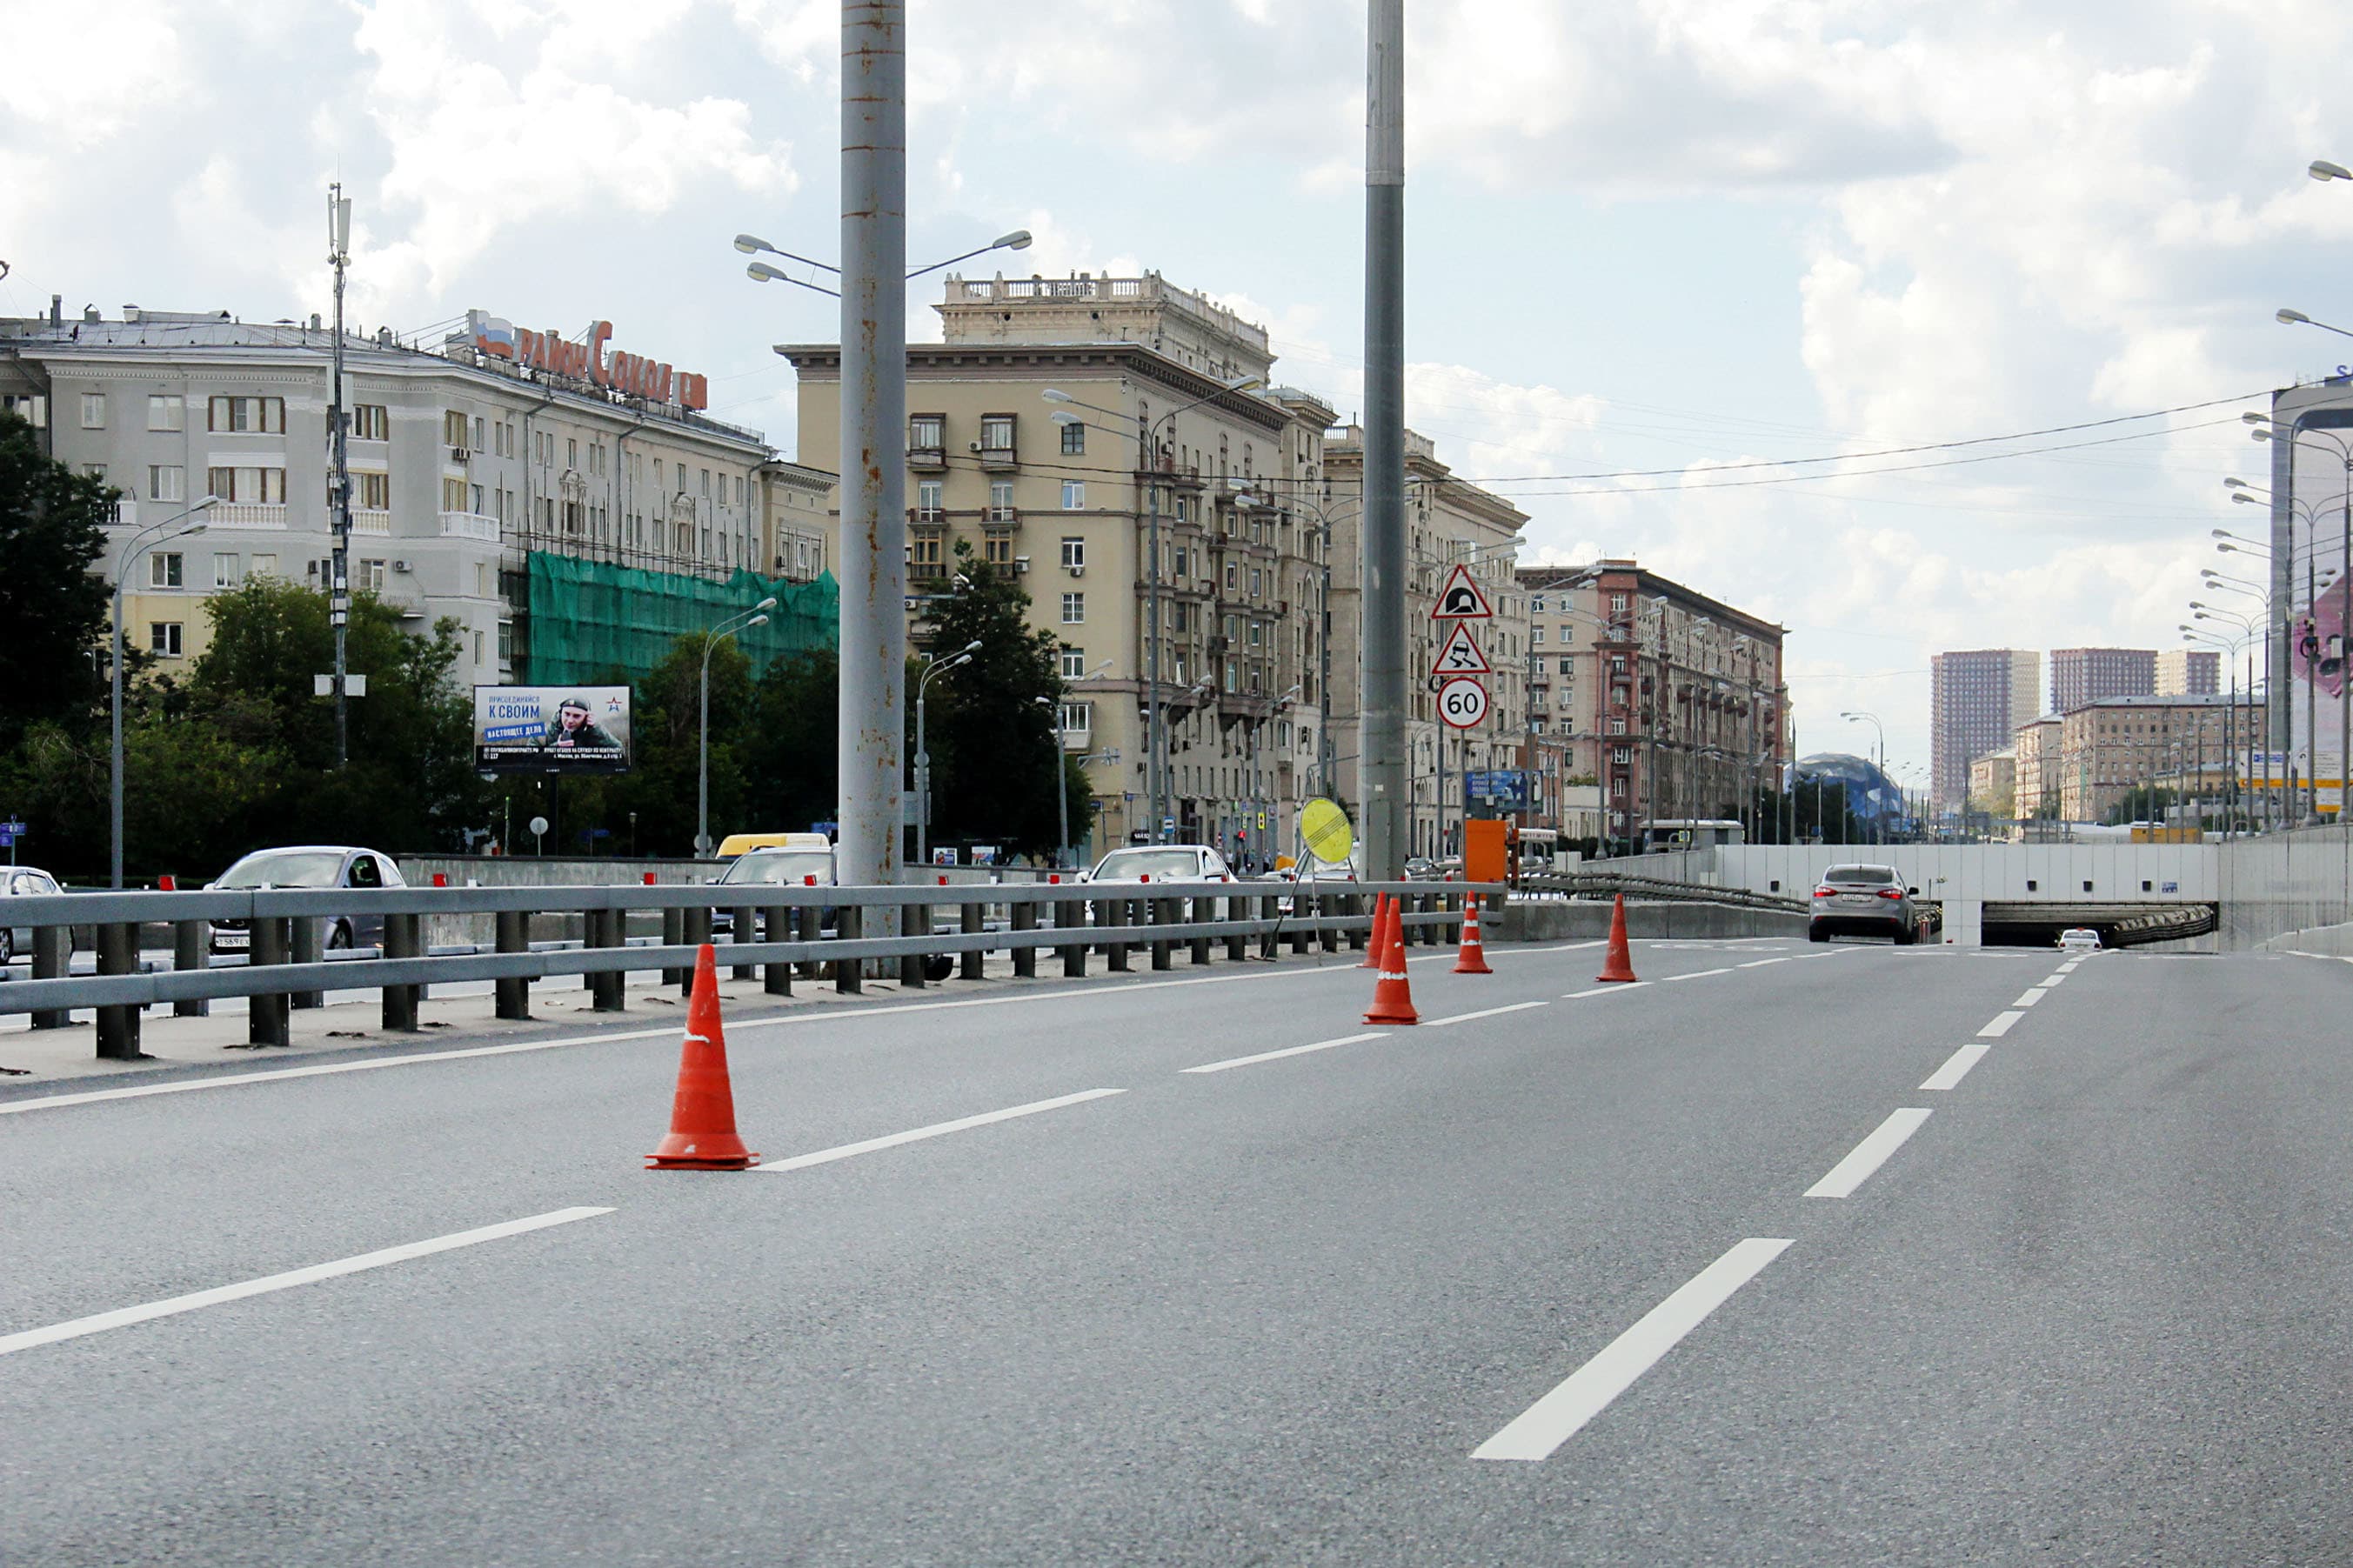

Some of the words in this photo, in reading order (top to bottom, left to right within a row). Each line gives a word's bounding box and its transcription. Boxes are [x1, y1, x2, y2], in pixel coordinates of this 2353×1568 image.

[1447, 692, 1479, 715] 60
[489, 705, 496, 718] К
[498, 705, 539, 718] СВОИМ
[487, 727, 524, 738] НАСТОЯЩЕЕ
[525, 725, 542, 736] ДЕЛО
